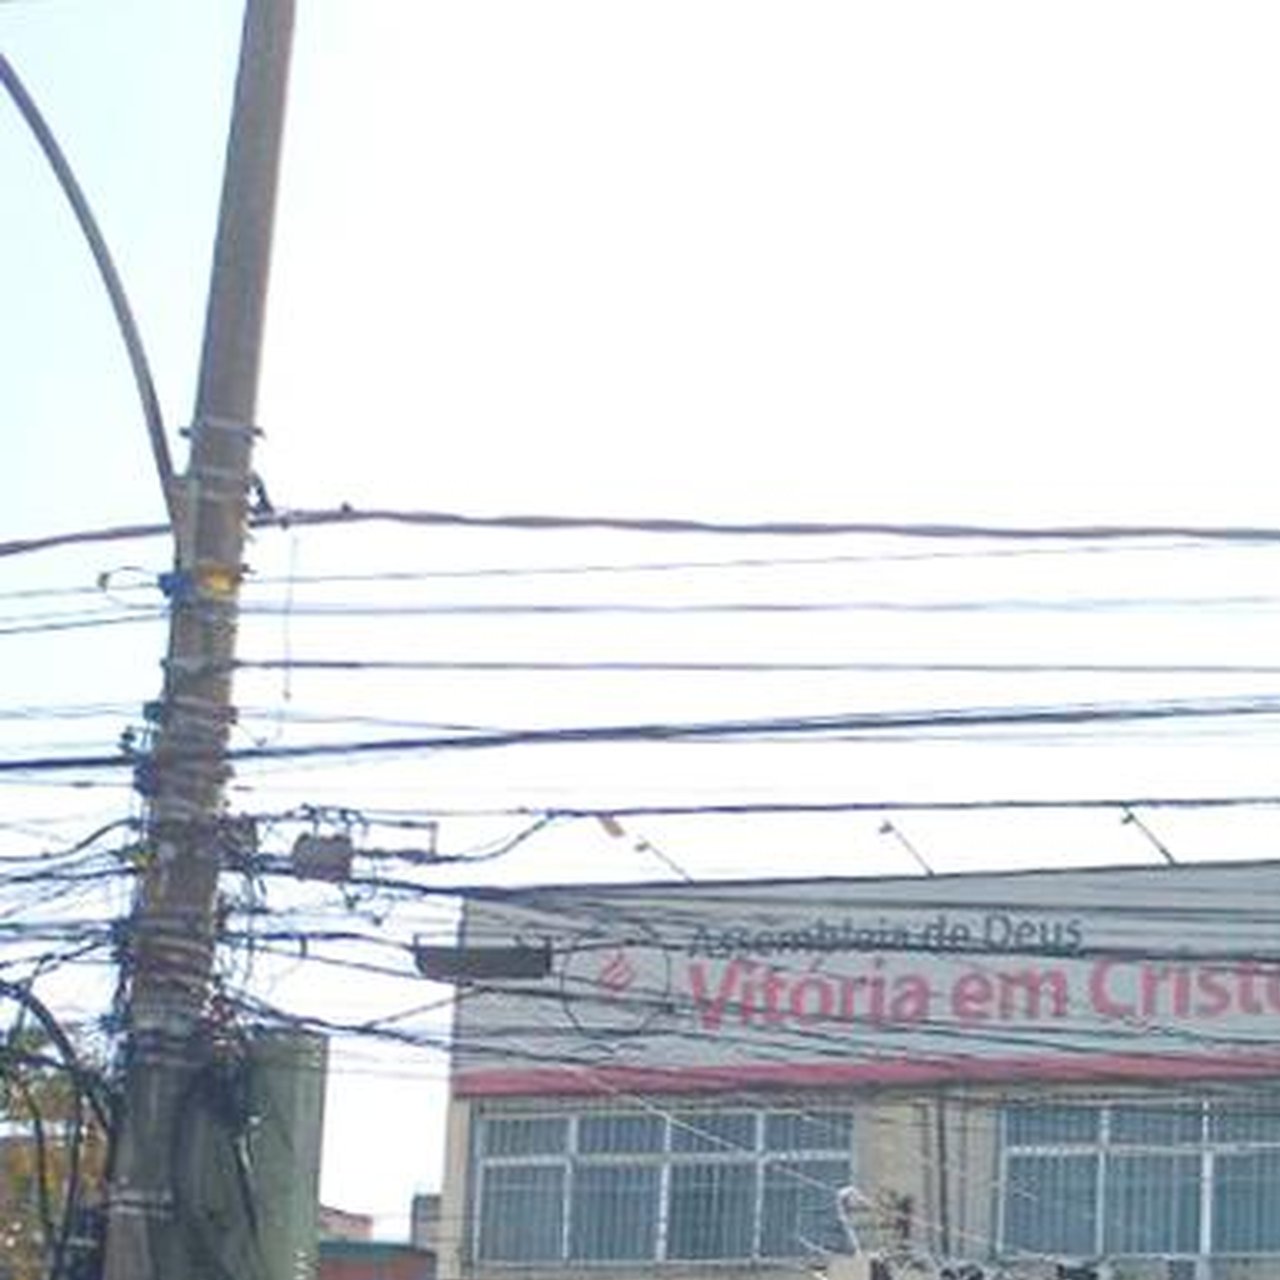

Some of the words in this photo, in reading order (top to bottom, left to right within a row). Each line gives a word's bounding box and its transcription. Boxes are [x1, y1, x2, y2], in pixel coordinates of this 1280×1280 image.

[924, 915, 973, 948] de
[984, 914, 1083, 950] Deus
[688, 958, 931, 1031] Vitória
[952, 965, 1068, 1022] em
